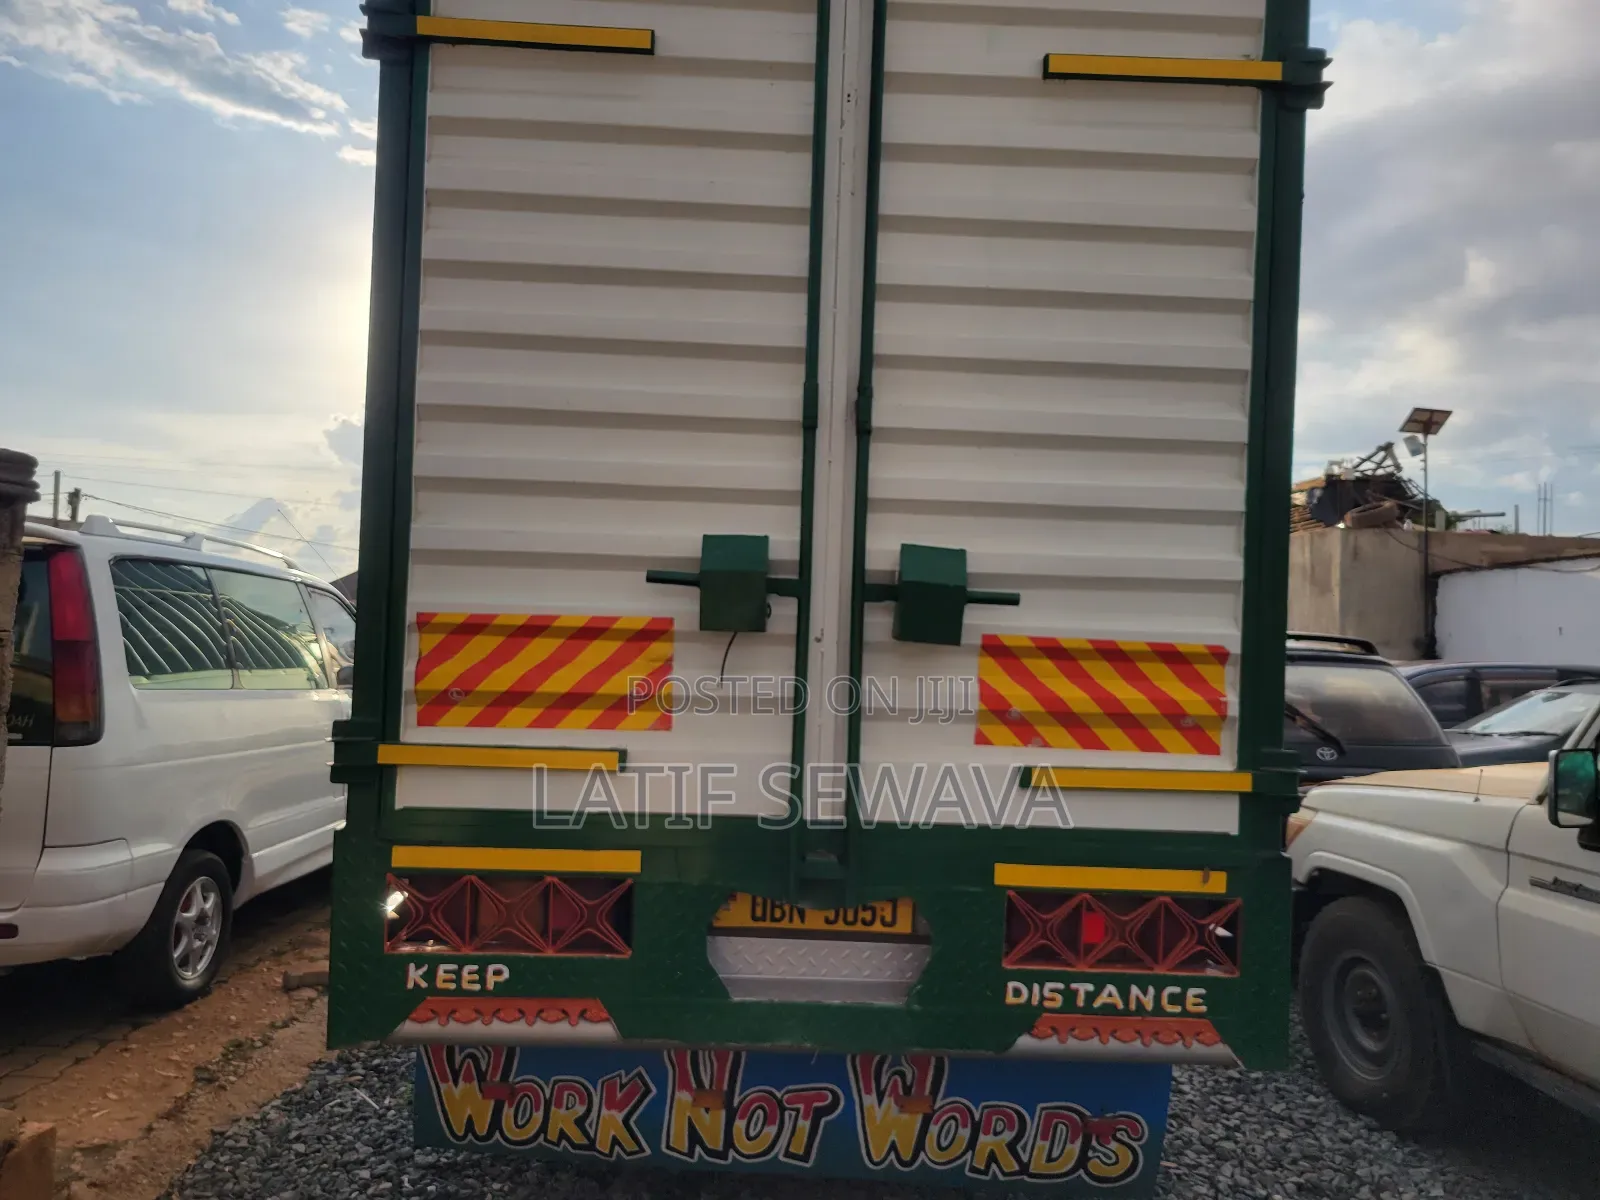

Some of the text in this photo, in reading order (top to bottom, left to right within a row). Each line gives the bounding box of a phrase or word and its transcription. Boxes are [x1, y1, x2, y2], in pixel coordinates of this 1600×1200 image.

[406, 962, 510, 991] KEEP
[1005, 980, 1208, 1013] DISTANCE
[420, 1045, 1149, 1188] WORK NOT WORDS
